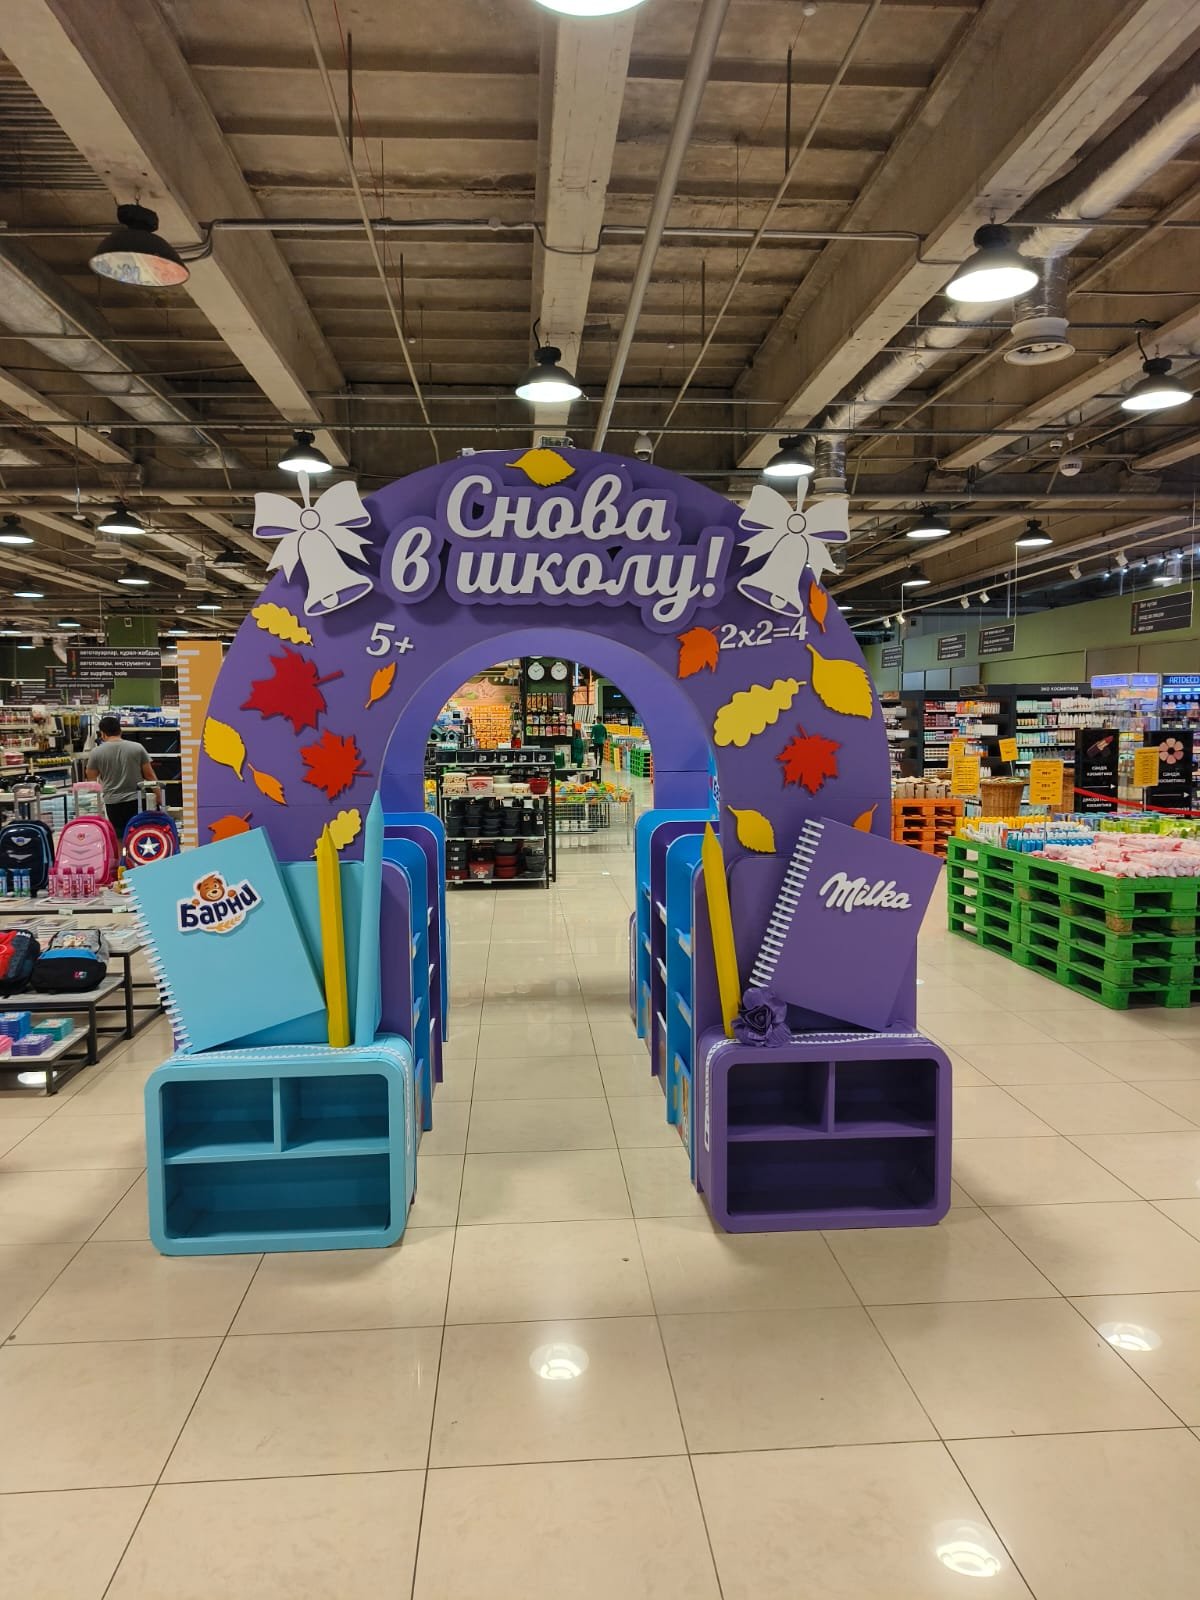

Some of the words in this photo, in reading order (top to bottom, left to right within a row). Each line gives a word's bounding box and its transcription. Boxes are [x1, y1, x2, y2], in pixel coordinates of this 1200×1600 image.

[446, 473, 671, 541] Снова
[391, 526, 432, 593] в
[456, 536, 724, 623] школу!
[365, 622, 414, 656] 5+
[1169, 676, 1200, 684] ARTDECO
[180, 884, 258, 928] Барни
[819, 872, 913, 912] Milka
